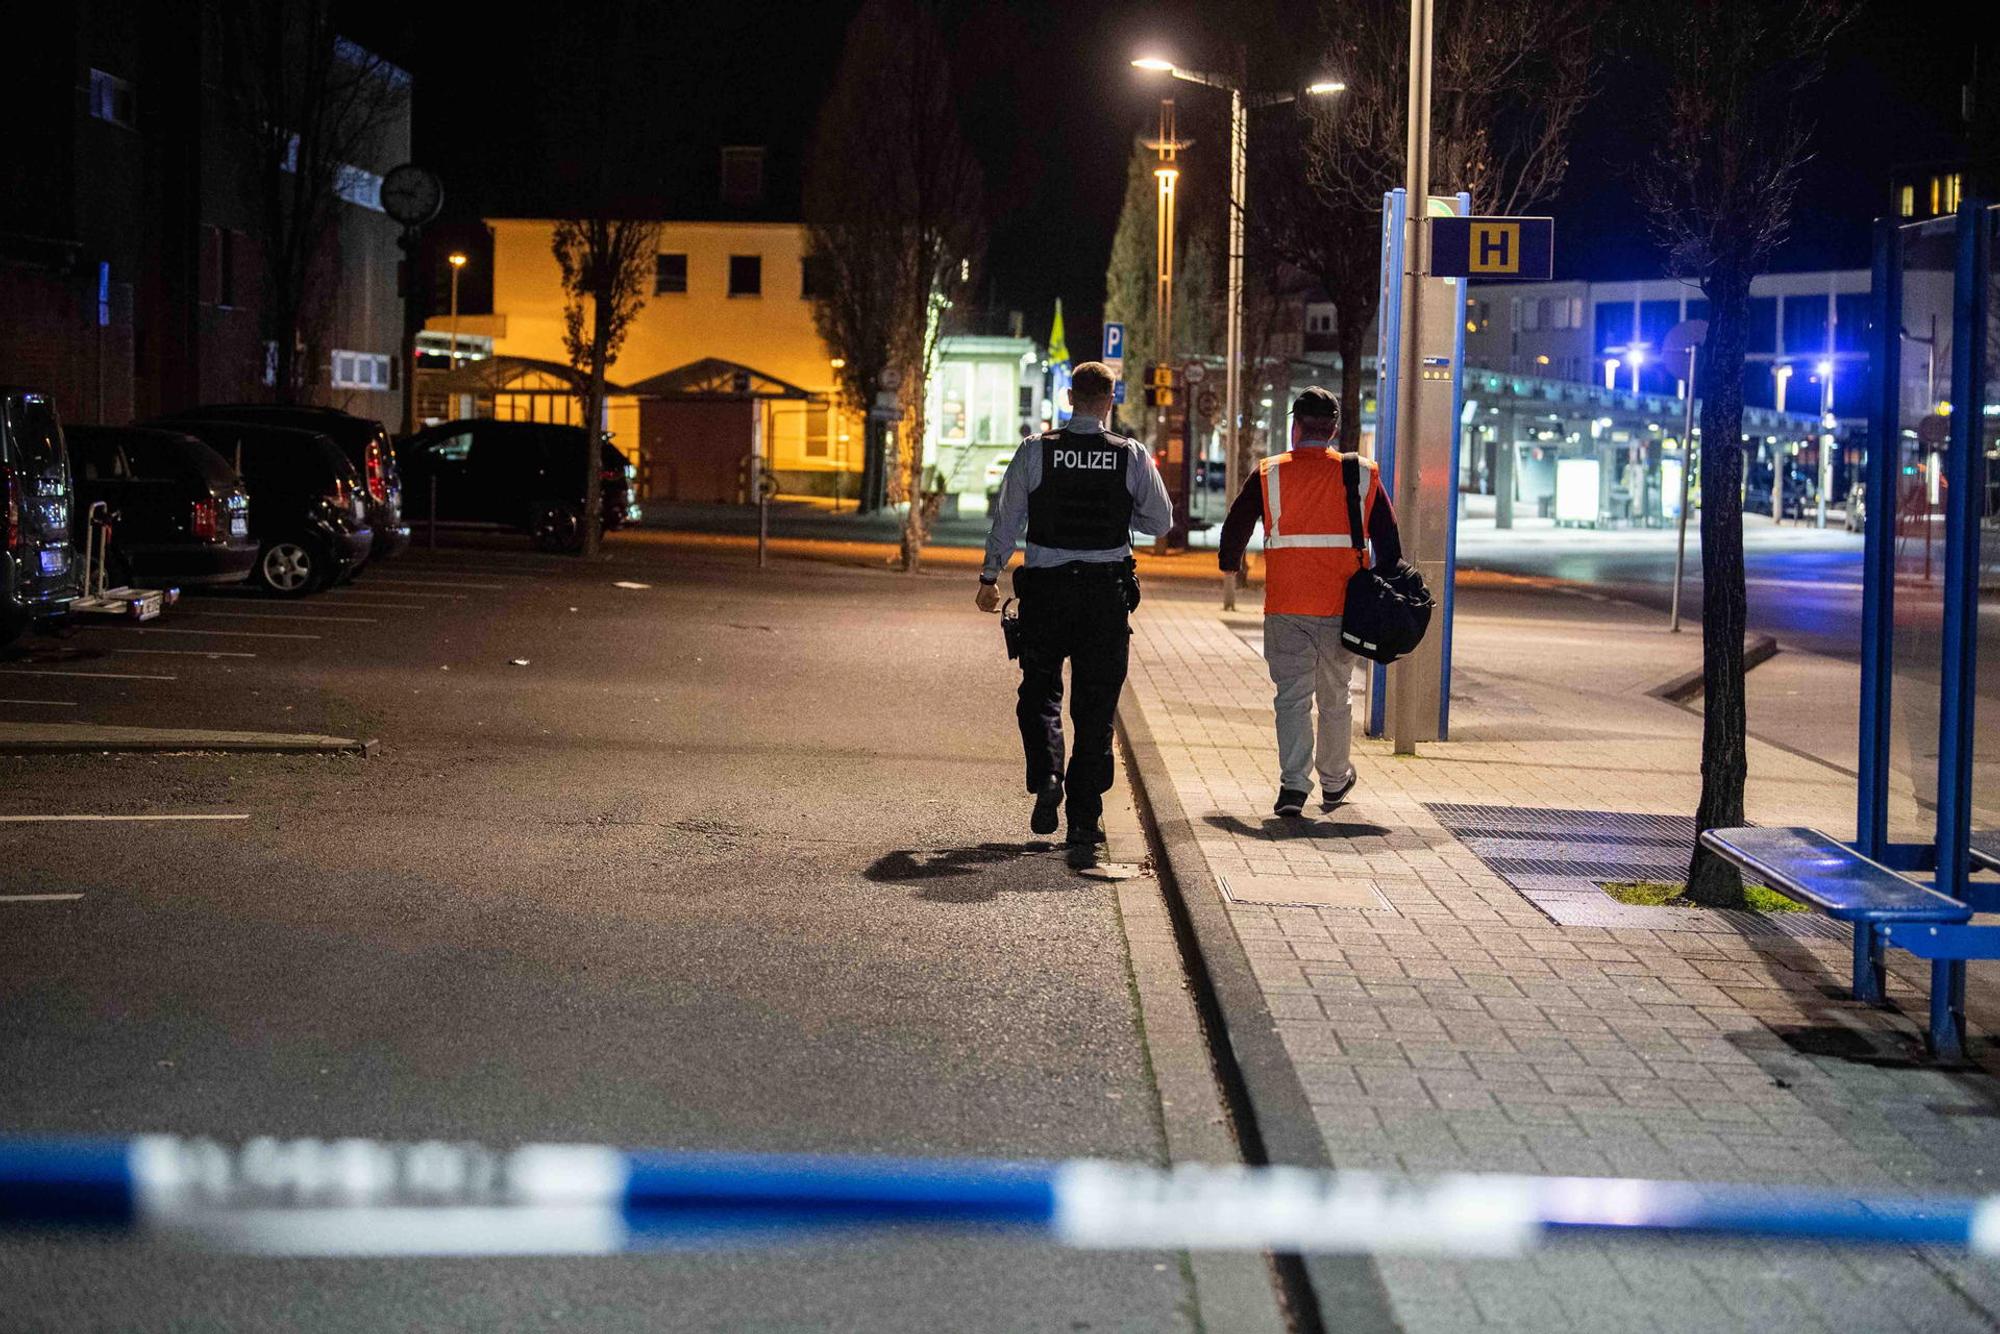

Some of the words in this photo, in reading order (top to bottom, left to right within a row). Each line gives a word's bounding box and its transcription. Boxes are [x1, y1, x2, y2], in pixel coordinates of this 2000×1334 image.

[1480, 230, 1509, 266] H
[1108, 326, 1121, 355] P
[1053, 449, 1118, 470] POLIZEI
